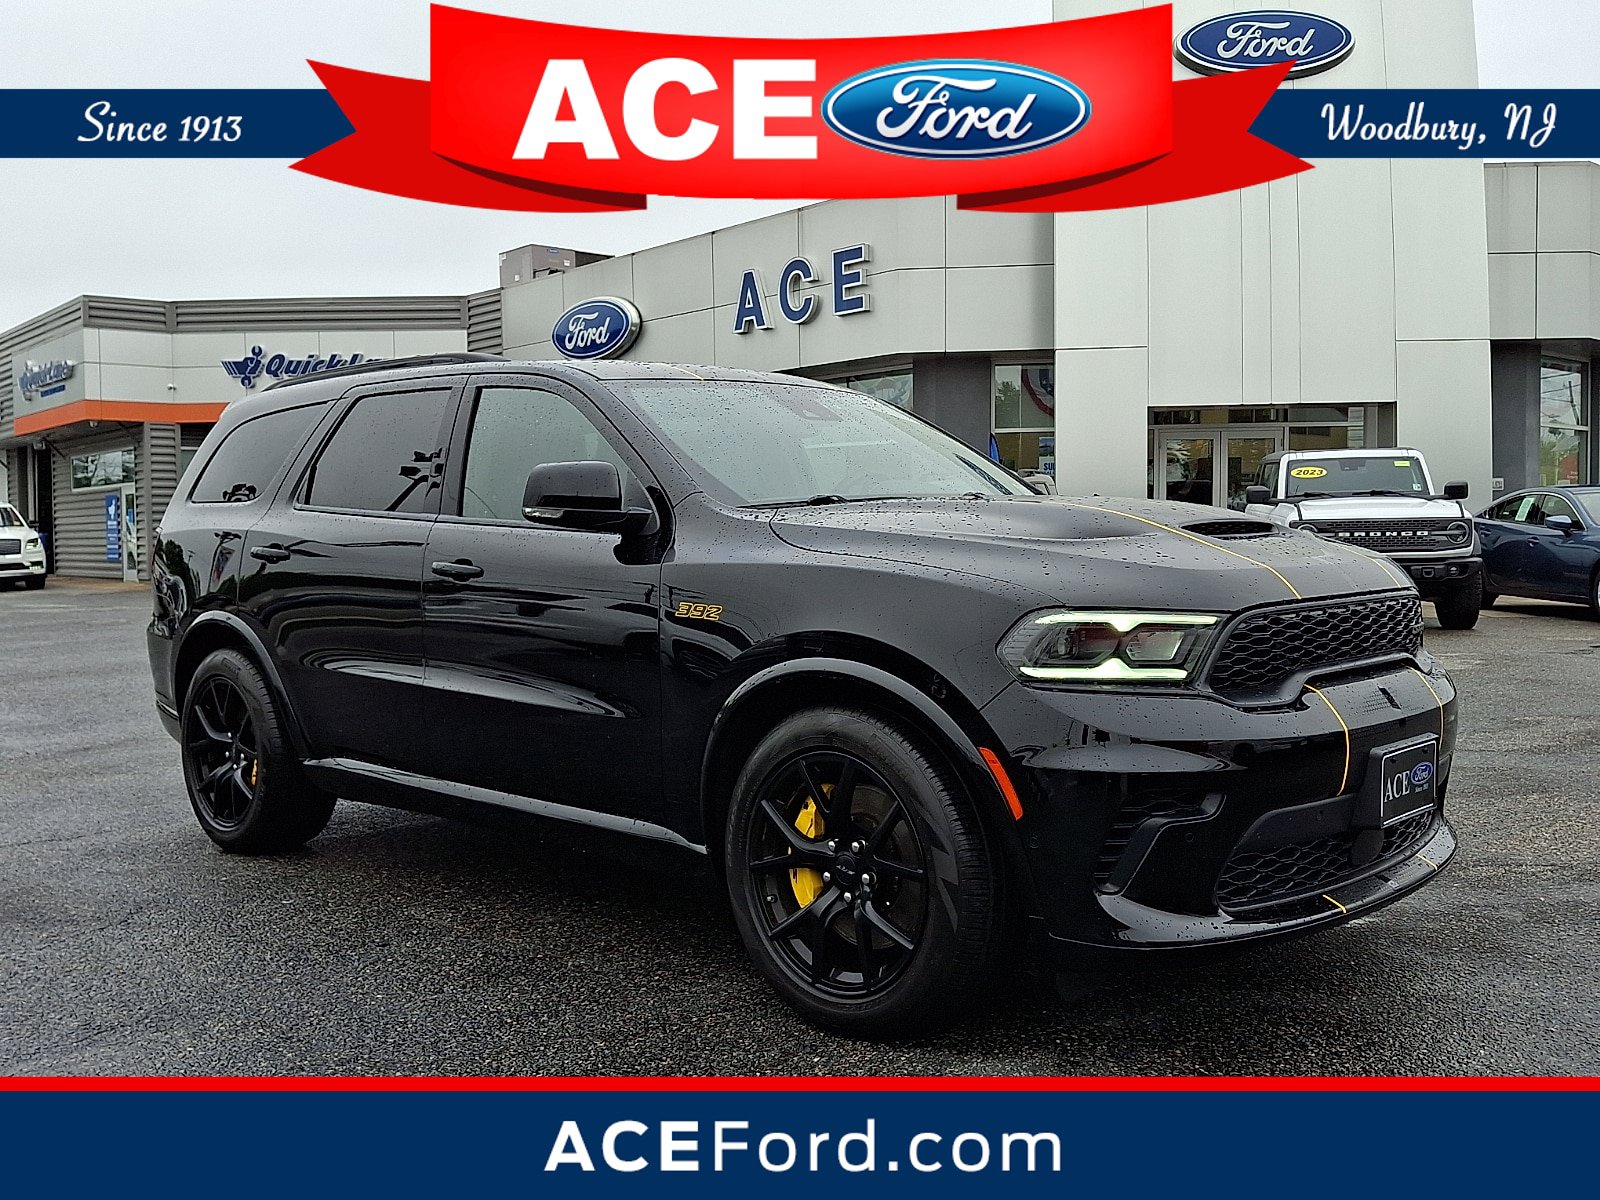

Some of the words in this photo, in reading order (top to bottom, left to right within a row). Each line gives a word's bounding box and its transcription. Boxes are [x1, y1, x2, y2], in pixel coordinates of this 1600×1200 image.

[1216, 21, 1316, 58] Ford
[732, 243, 870, 334] ACE
[564, 311, 611, 350] Ford
[1338, 530, 1429, 538] BRONCO
[675, 602, 723, 620] 392
[1384, 770, 1411, 802] ACE
